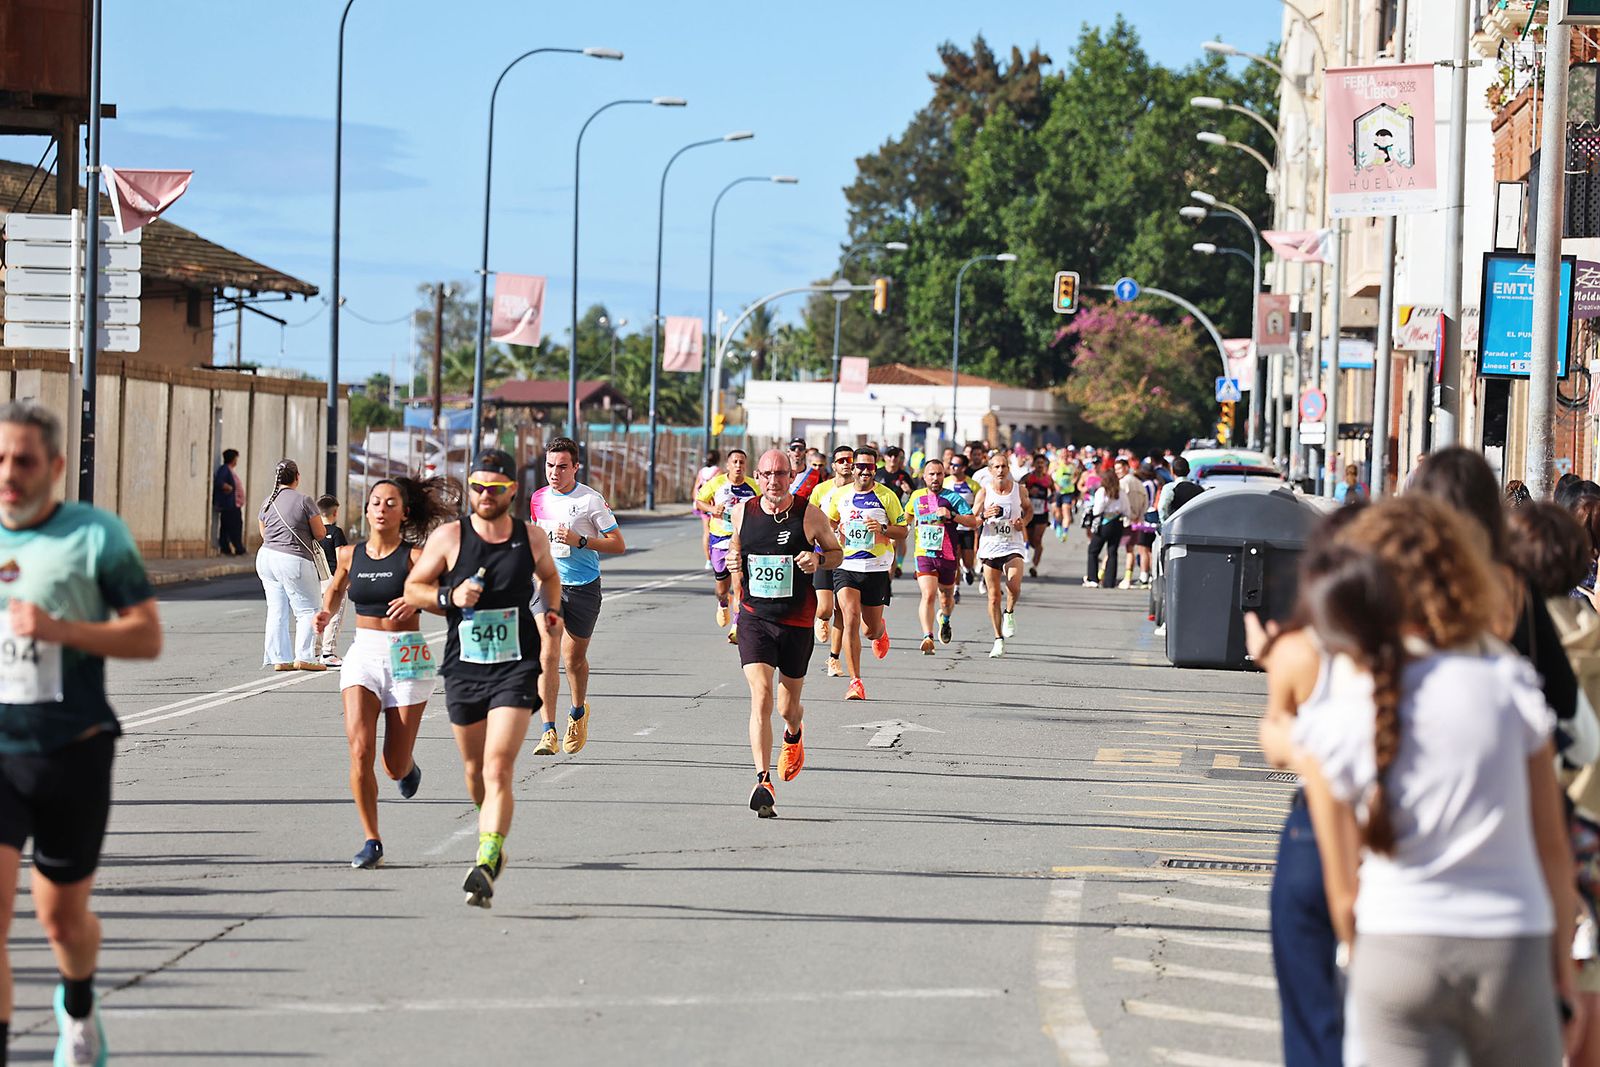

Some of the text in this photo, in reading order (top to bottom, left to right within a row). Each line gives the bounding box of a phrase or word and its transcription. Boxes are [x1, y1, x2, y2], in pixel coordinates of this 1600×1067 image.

[1344, 74, 1377, 89] FERIA
[1365, 86, 1398, 99] LIBRO
[1349, 176, 1415, 190] HUELVA
[1484, 350, 1508, 359] Parada
[850, 510, 864, 520] 2K
[848, 529, 869, 540] 467
[994, 525, 1011, 535] 140
[755, 567, 785, 582] 296
[471, 623, 509, 643] 540
[399, 644, 432, 663] 276
